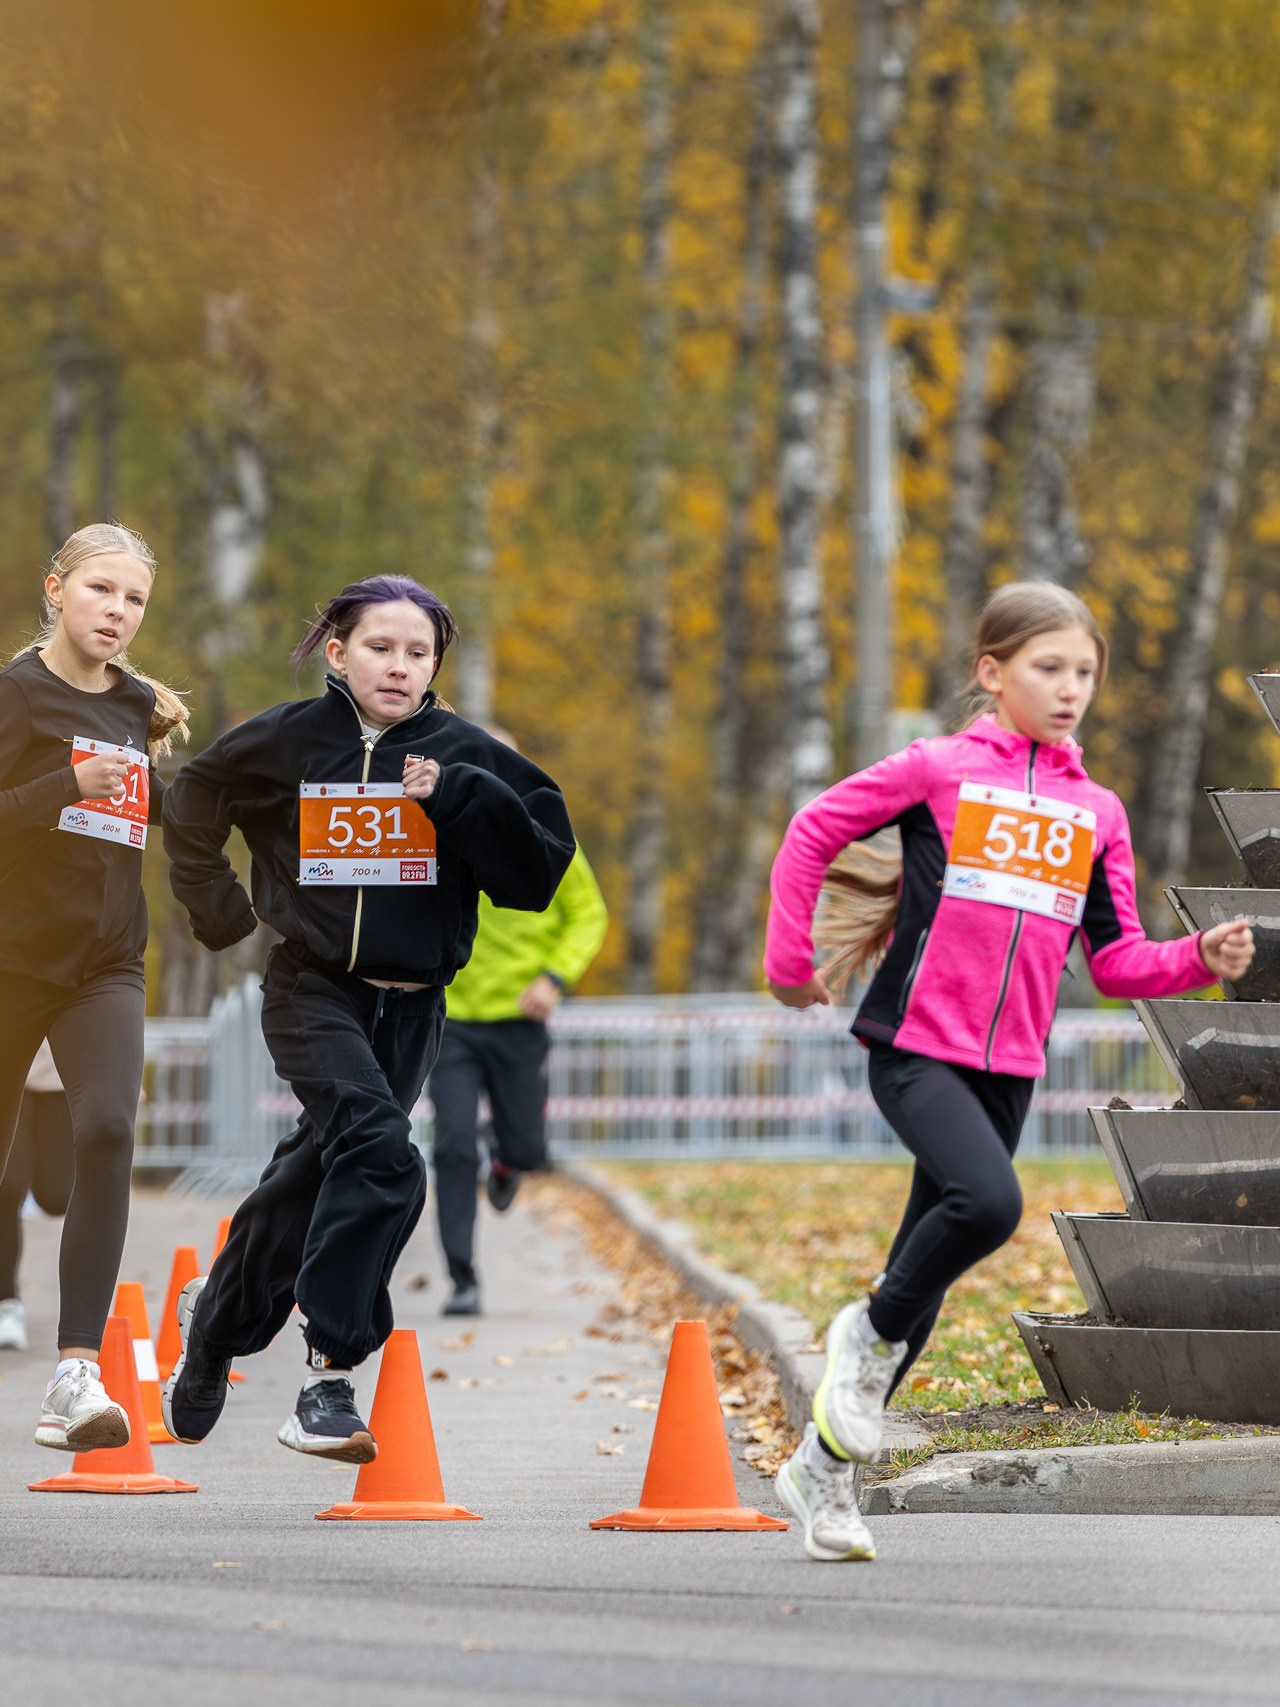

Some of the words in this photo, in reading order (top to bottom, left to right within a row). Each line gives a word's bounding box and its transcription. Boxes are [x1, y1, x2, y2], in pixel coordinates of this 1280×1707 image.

[101, 823, 114, 832] 400
[327, 805, 408, 848] 531
[982, 813, 1075, 868] 518
[351, 868, 370, 877] 700
